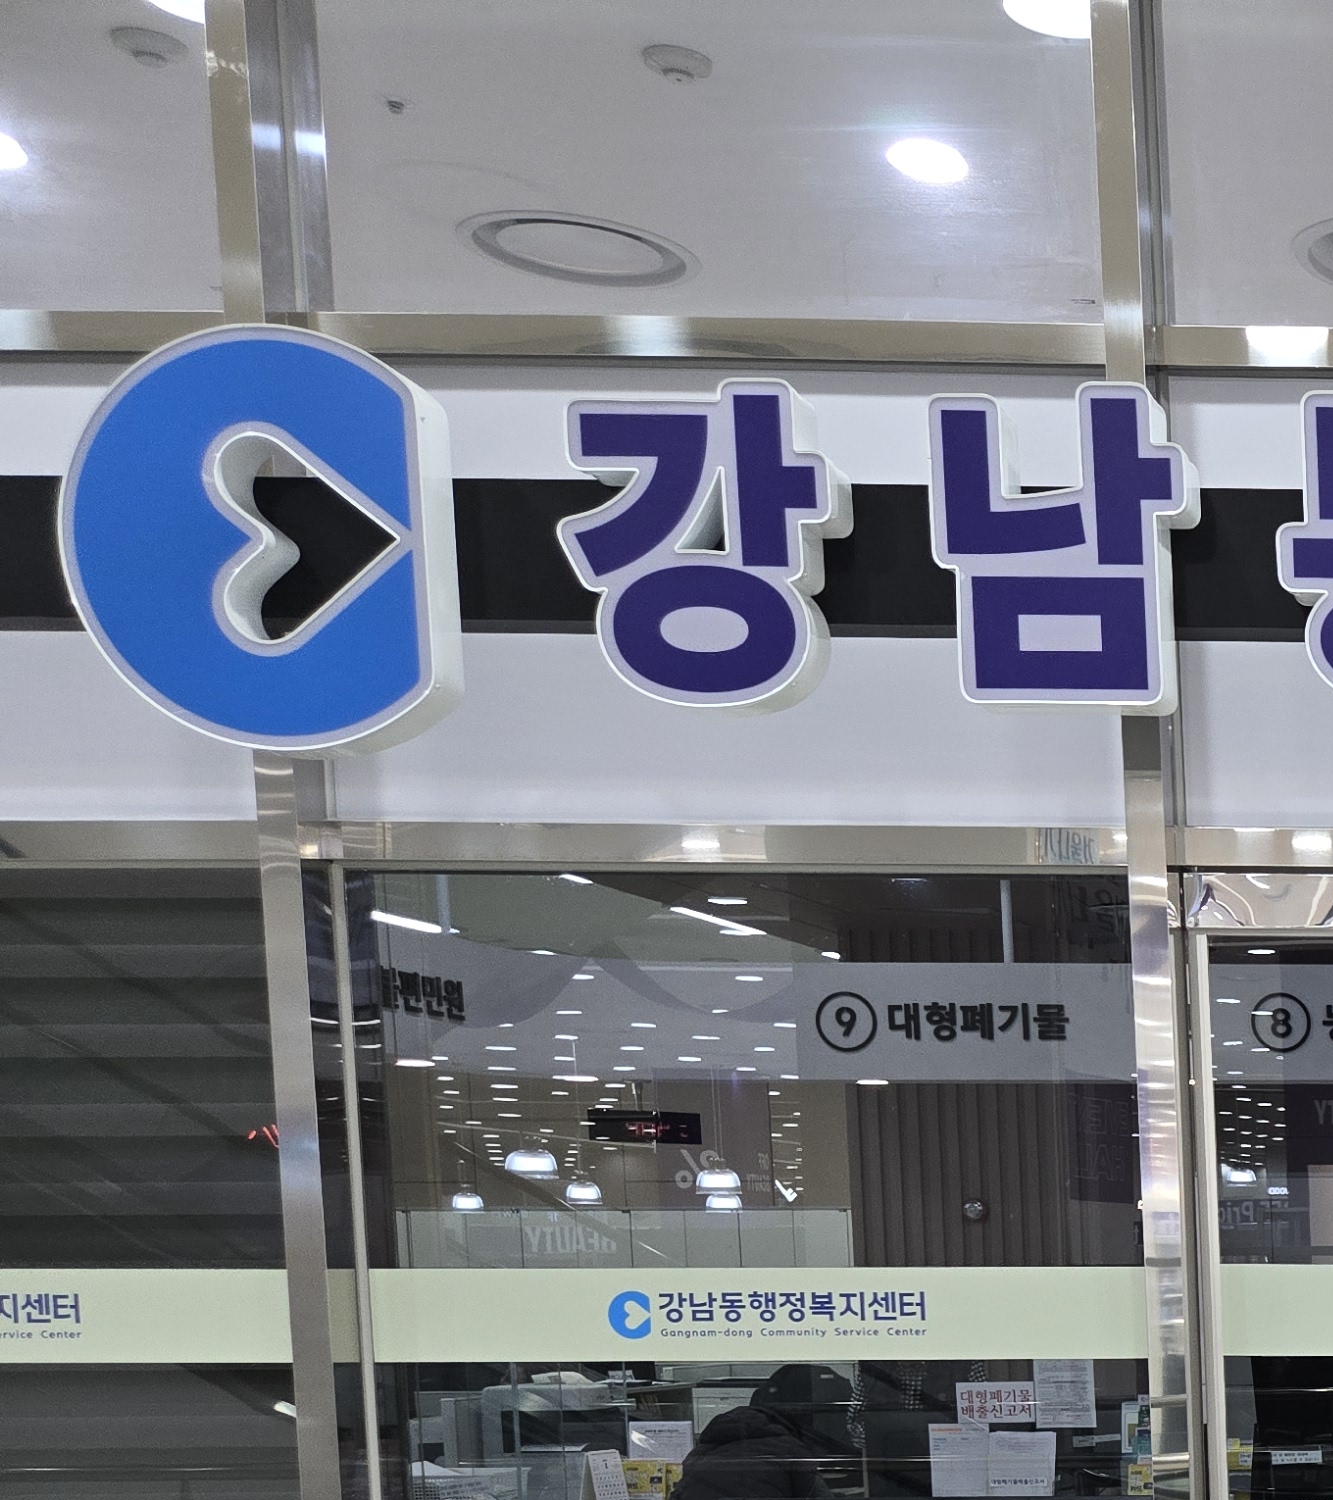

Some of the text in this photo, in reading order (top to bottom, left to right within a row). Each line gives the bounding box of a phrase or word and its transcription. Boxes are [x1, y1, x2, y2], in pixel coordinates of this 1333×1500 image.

[888, 1002, 1069, 1041] 대형폐기물
[659, 1291, 925, 1323] 강남동행정복지센터
[41, 1330, 82, 1339] Center
[661, 1328, 752, 1338] Gangnam-dong
[761, 1328, 826, 1337] Community
[835, 1328, 879, 1336] Service
[960, 1388, 1032, 1403] 대형폐기물
[960, 1403, 1032, 1419] 배출신고서
